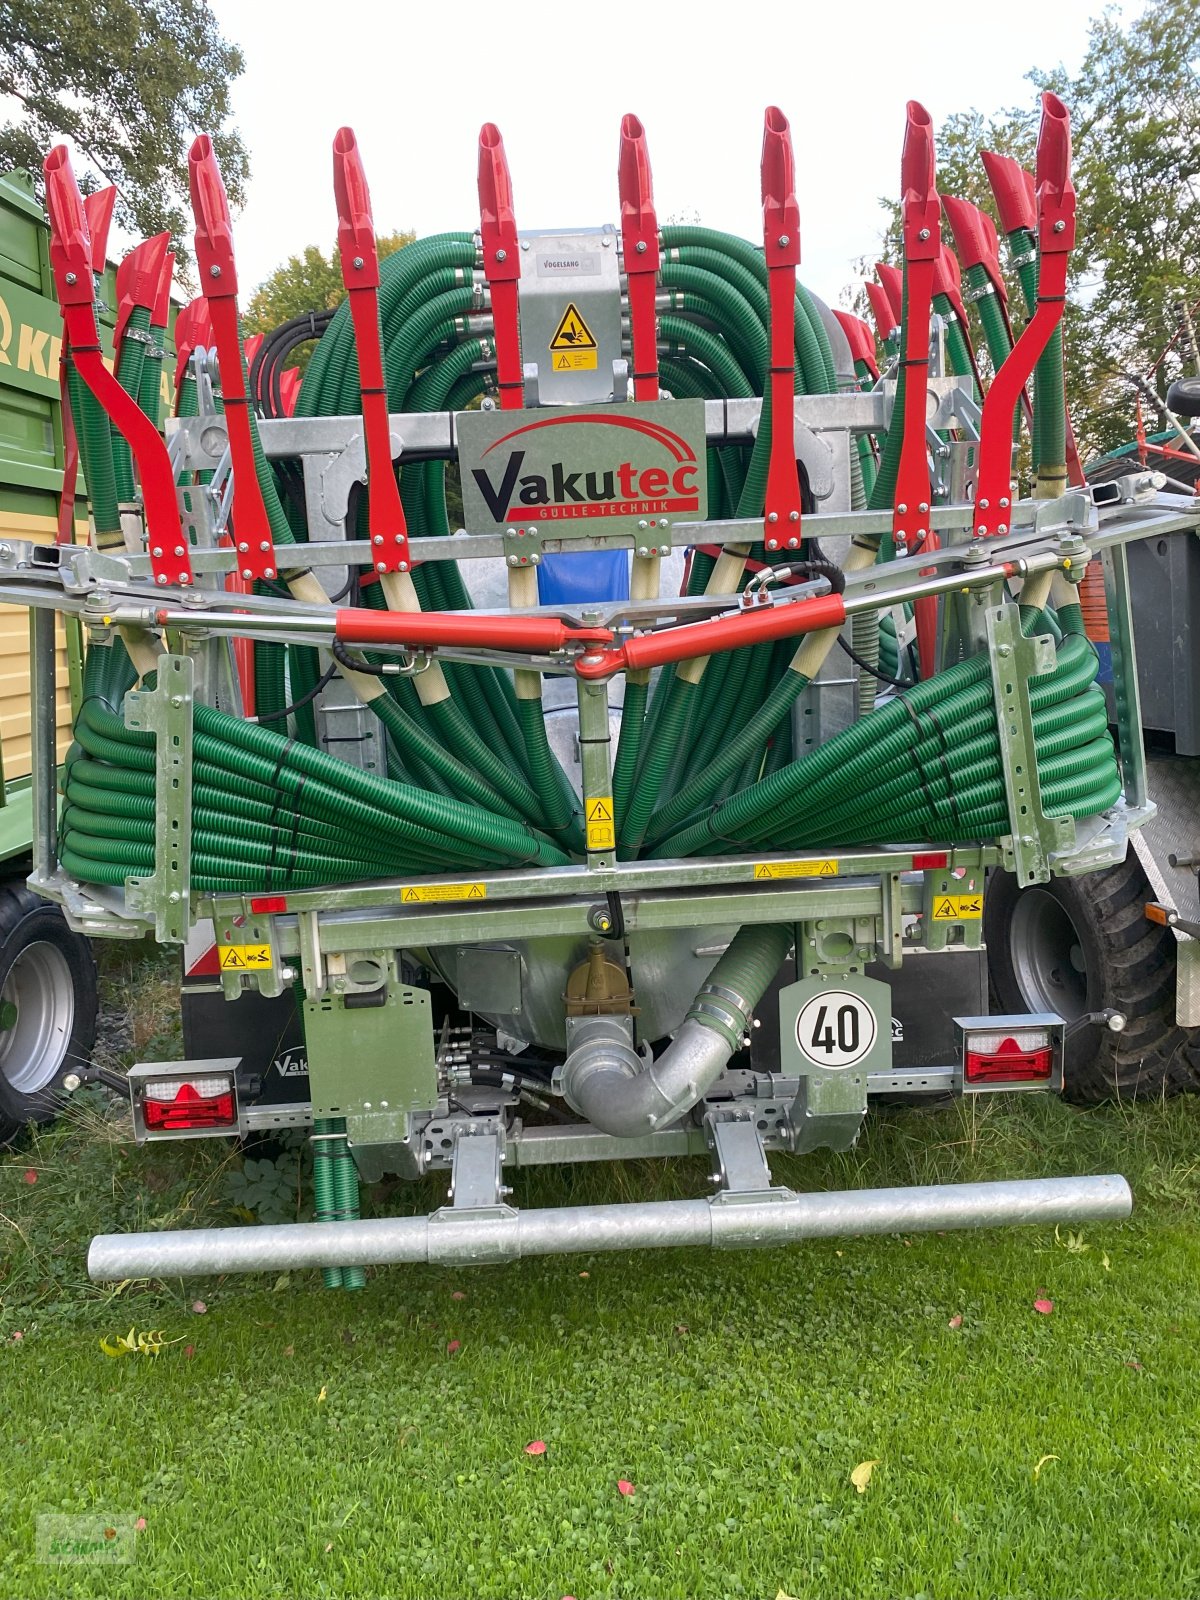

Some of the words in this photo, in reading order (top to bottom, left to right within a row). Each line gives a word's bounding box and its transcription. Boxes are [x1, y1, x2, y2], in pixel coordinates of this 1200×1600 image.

[544, 260, 579, 268] VOGELSANG
[471, 451, 699, 523] Vakutec
[540, 502, 669, 518] GÜLLE-TECHNIK
[811, 1005, 859, 1053] 40
[274, 1055, 308, 1076] Vak
